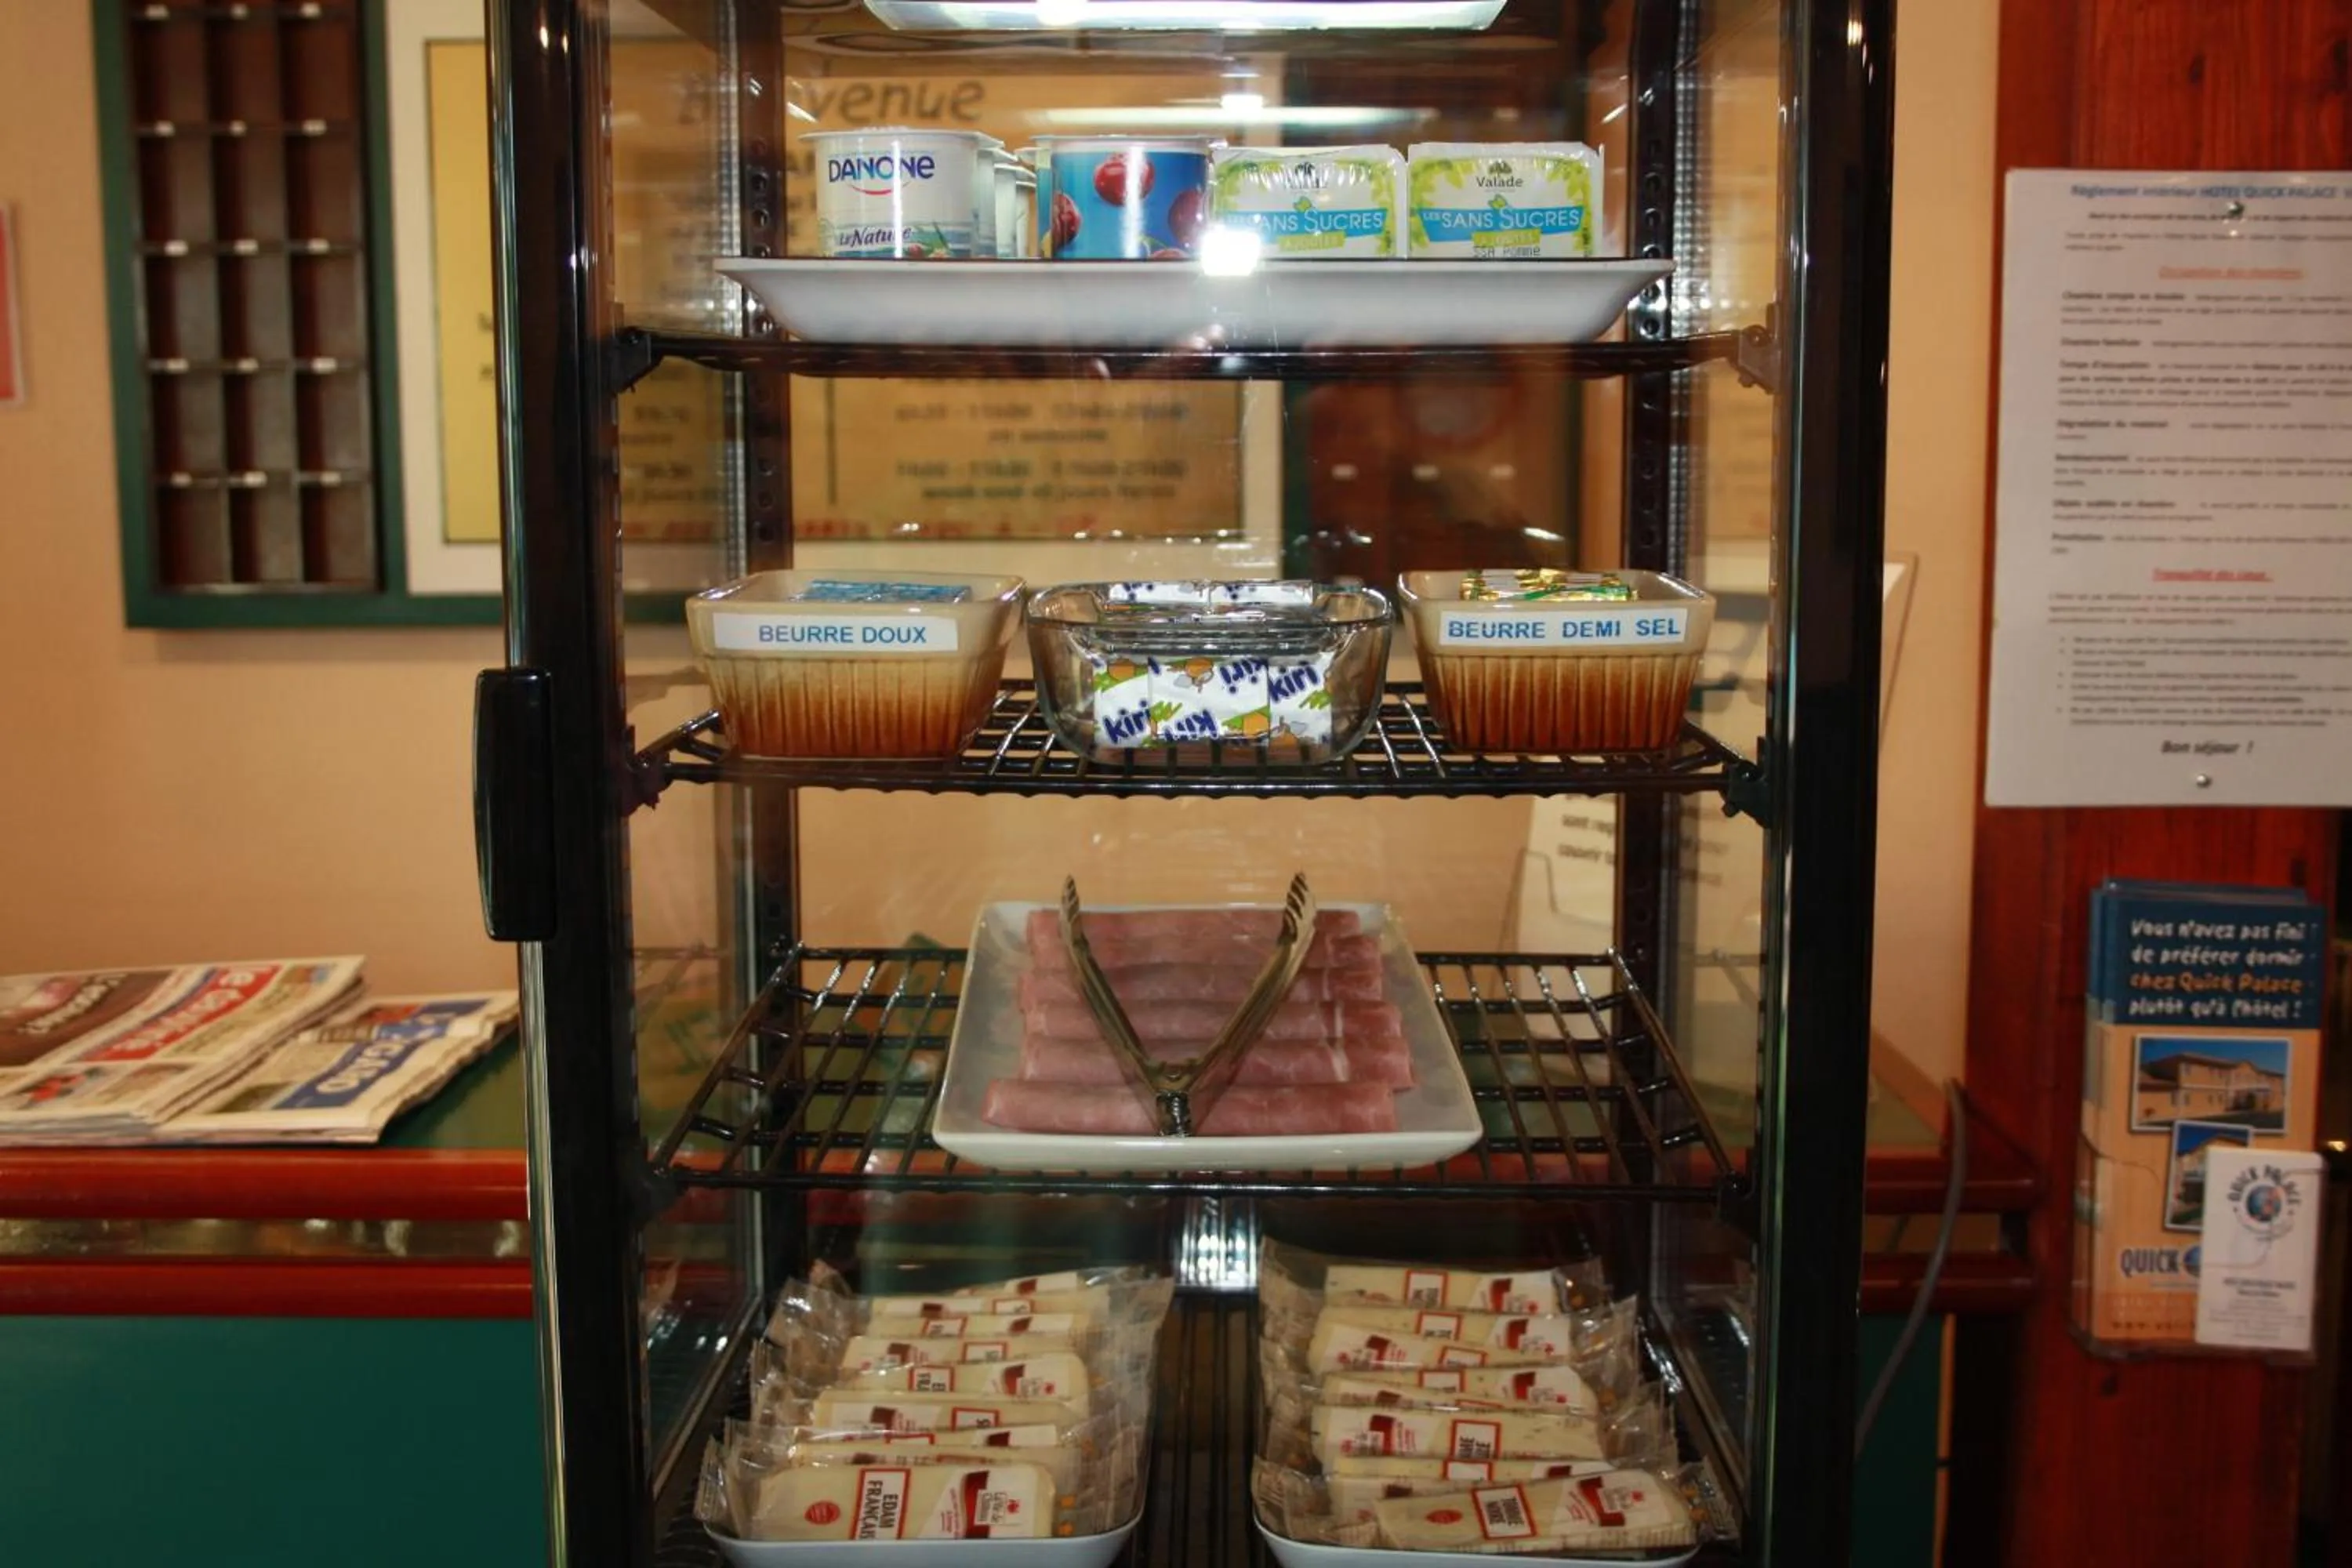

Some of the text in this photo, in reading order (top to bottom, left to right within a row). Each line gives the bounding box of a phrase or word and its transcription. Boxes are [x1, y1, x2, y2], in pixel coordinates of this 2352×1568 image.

[1476, 176, 1523, 187] Valade
[1246, 213, 1298, 233] ANS
[1304, 209, 1384, 233] SUCRES
[1441, 212, 1494, 230] SANS
[1499, 208, 1580, 229] SUCRES
[758, 625, 927, 644] BEURRE DOUX
[1448, 618, 1681, 639] BEURRE DEMI SEL
[1268, 660, 1319, 702] kiri
[2129, 918, 2175, 938] Vous
[2178, 919, 2236, 940] n'avez
[2240, 924, 2271, 940] pas
[2130, 944, 2155, 964] de
[2245, 947, 2305, 967] dormir
[2129, 972, 2176, 990] chez
[2120, 1248, 2180, 1278] QUICK
[877, 1492, 899, 1530] EDAM
